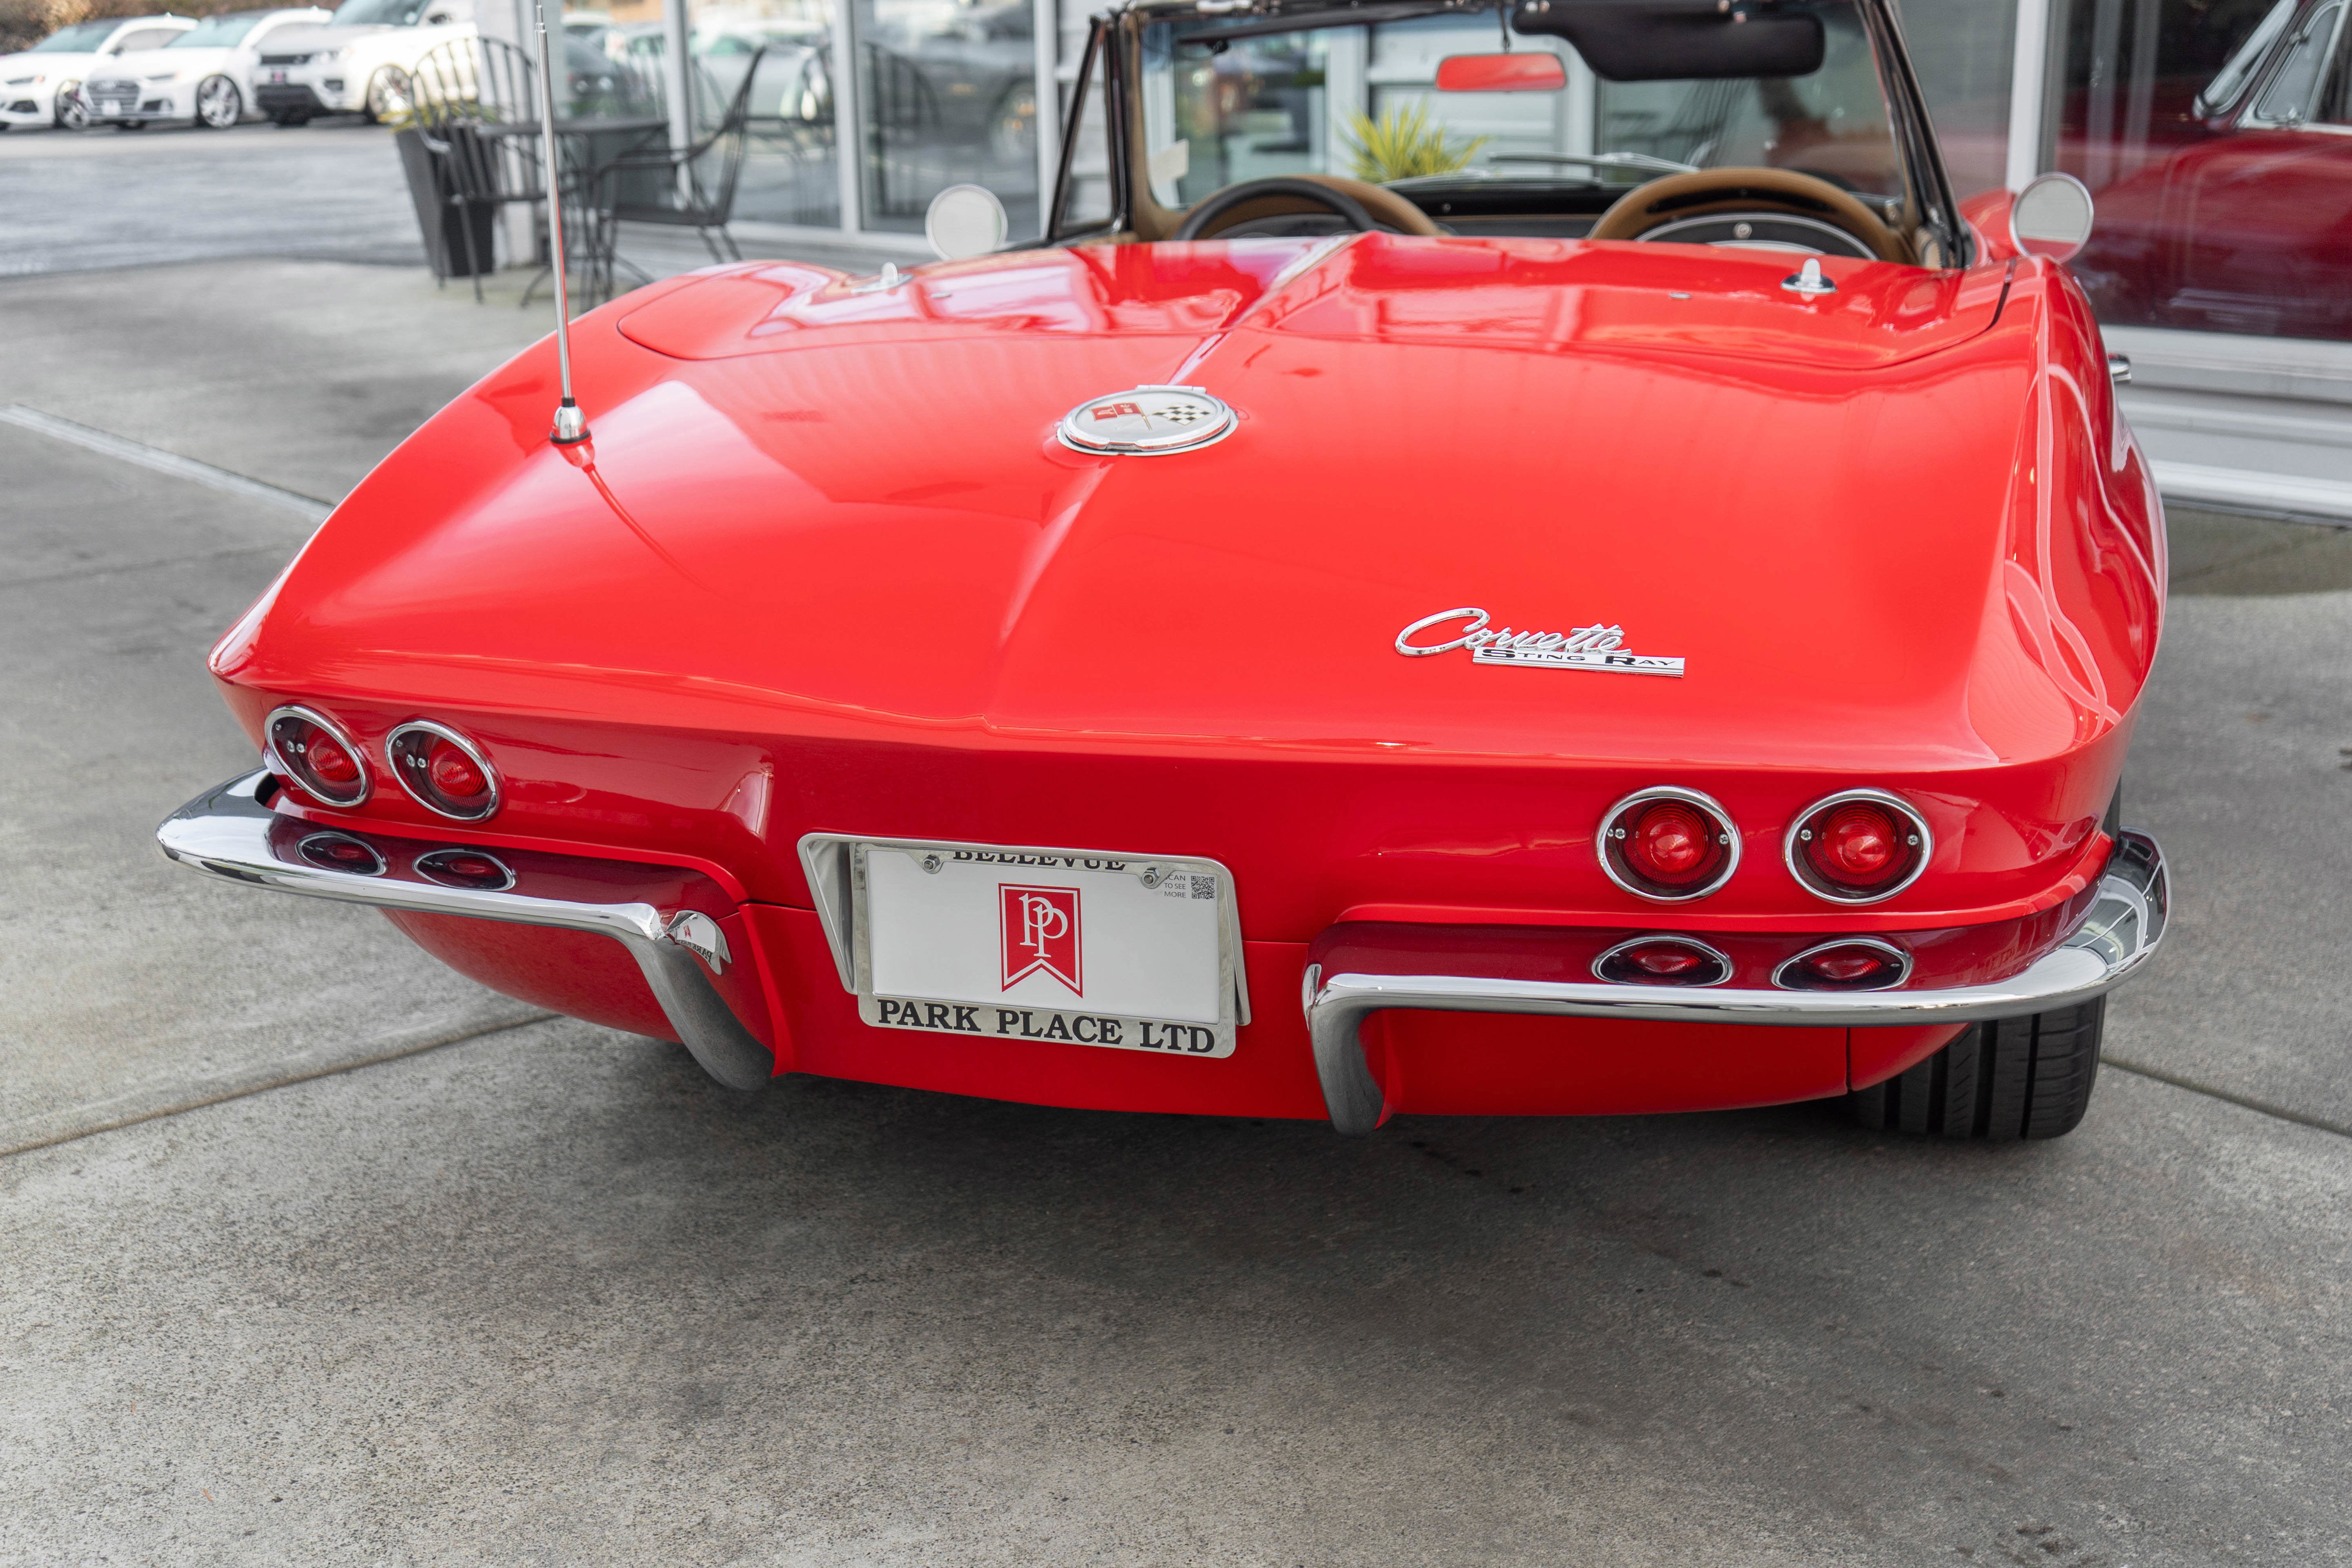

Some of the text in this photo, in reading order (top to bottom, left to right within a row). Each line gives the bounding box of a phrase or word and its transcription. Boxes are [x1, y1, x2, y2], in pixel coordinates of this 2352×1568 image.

[1395, 607, 1633, 657] Corvette
[878, 999, 1215, 1053] PARK PLACE LTD
